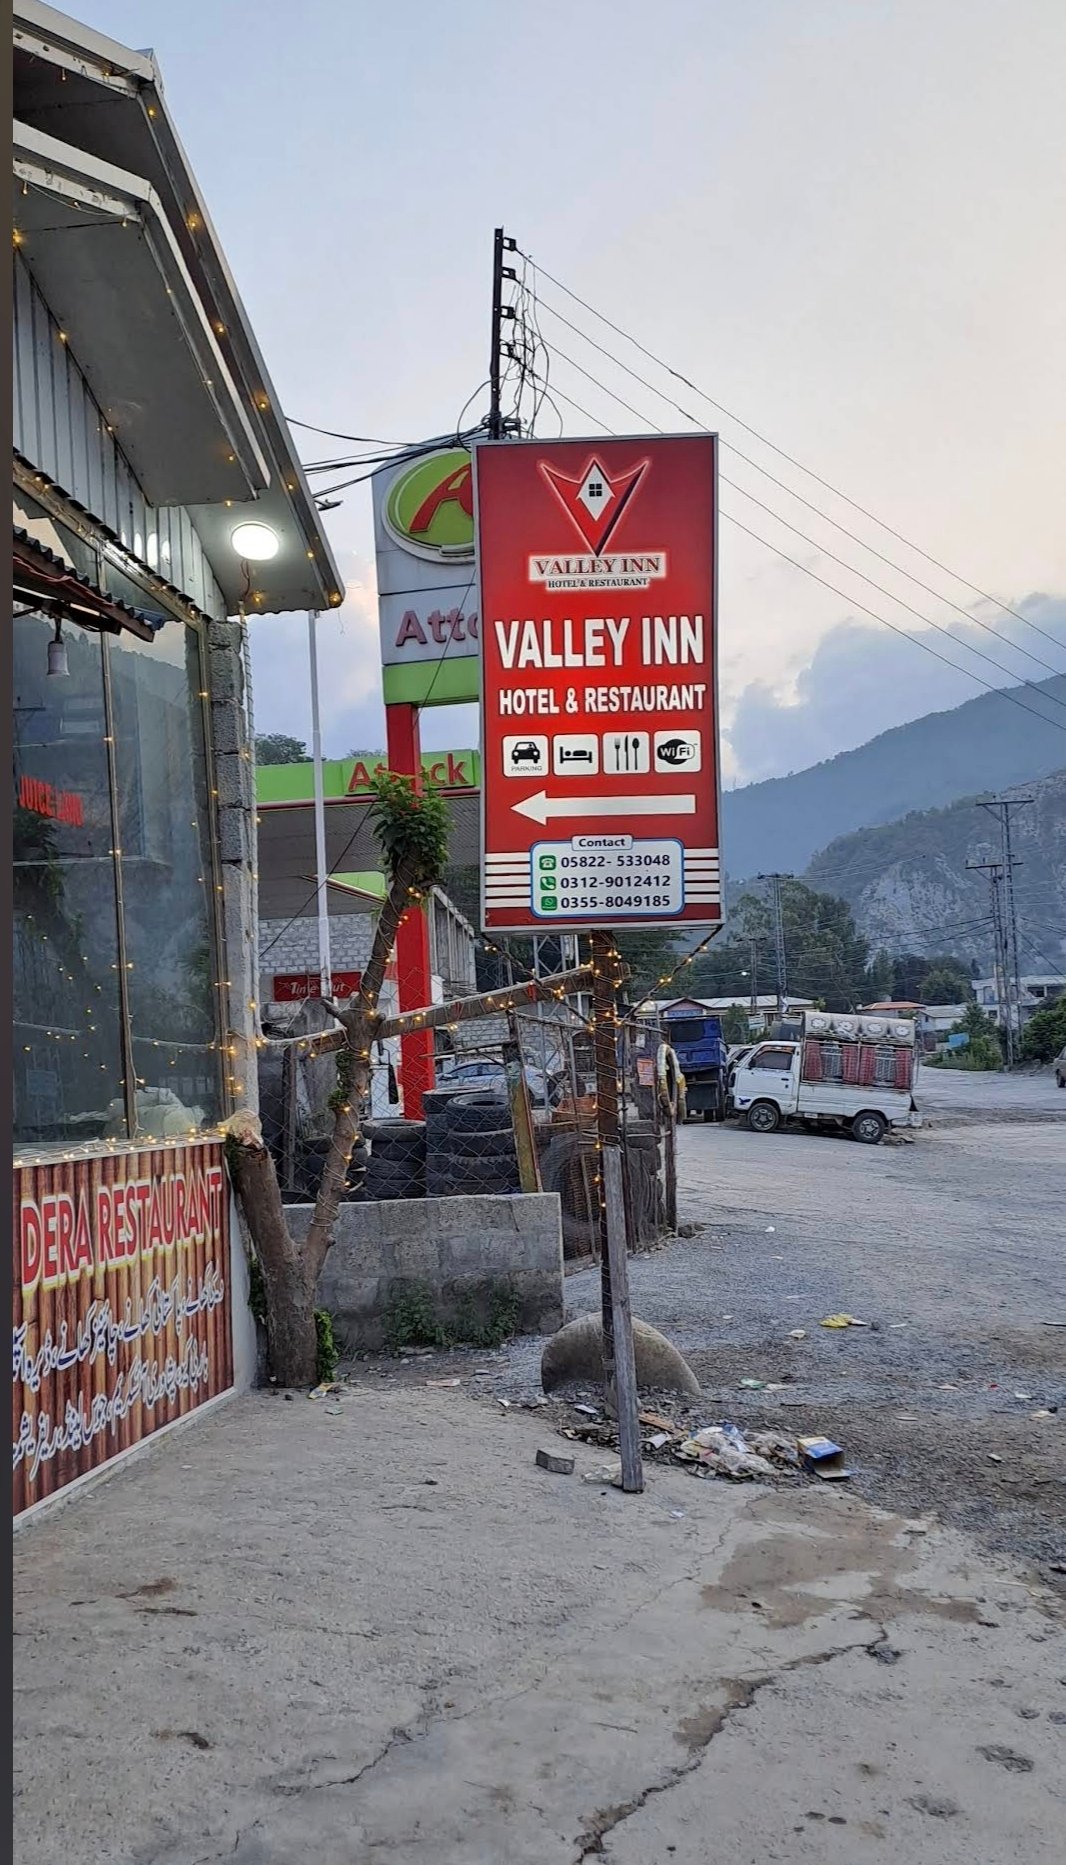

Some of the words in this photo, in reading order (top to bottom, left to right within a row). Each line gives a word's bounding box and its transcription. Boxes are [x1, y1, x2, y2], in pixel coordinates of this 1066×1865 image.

[534, 559, 617, 576] VALLEY
[623, 557, 660, 572] INN
[548, 579, 579, 588] HOTEL
[579, 579, 586, 587] &
[588, 577, 648, 587] RESTAURANT
[396, 608, 479, 646] Att
[494, 617, 630, 669] VALLEY
[641, 615, 704, 665] INN
[500, 687, 560, 715] HOTEL
[565, 687, 578, 713] &
[585, 684, 706, 713] RESTAURANT
[348, 753, 468, 792] Ack
[578, 838, 626, 848] Contact
[561, 856, 612, 868] 05822-
[617, 854, 670, 866] 533048
[561, 875, 670, 889] 0312-9012412
[561, 895, 670, 909] 0355-8049185
[20, 1194, 94, 1294] DERA
[98, 1166, 223, 1268] RESTAURANT
